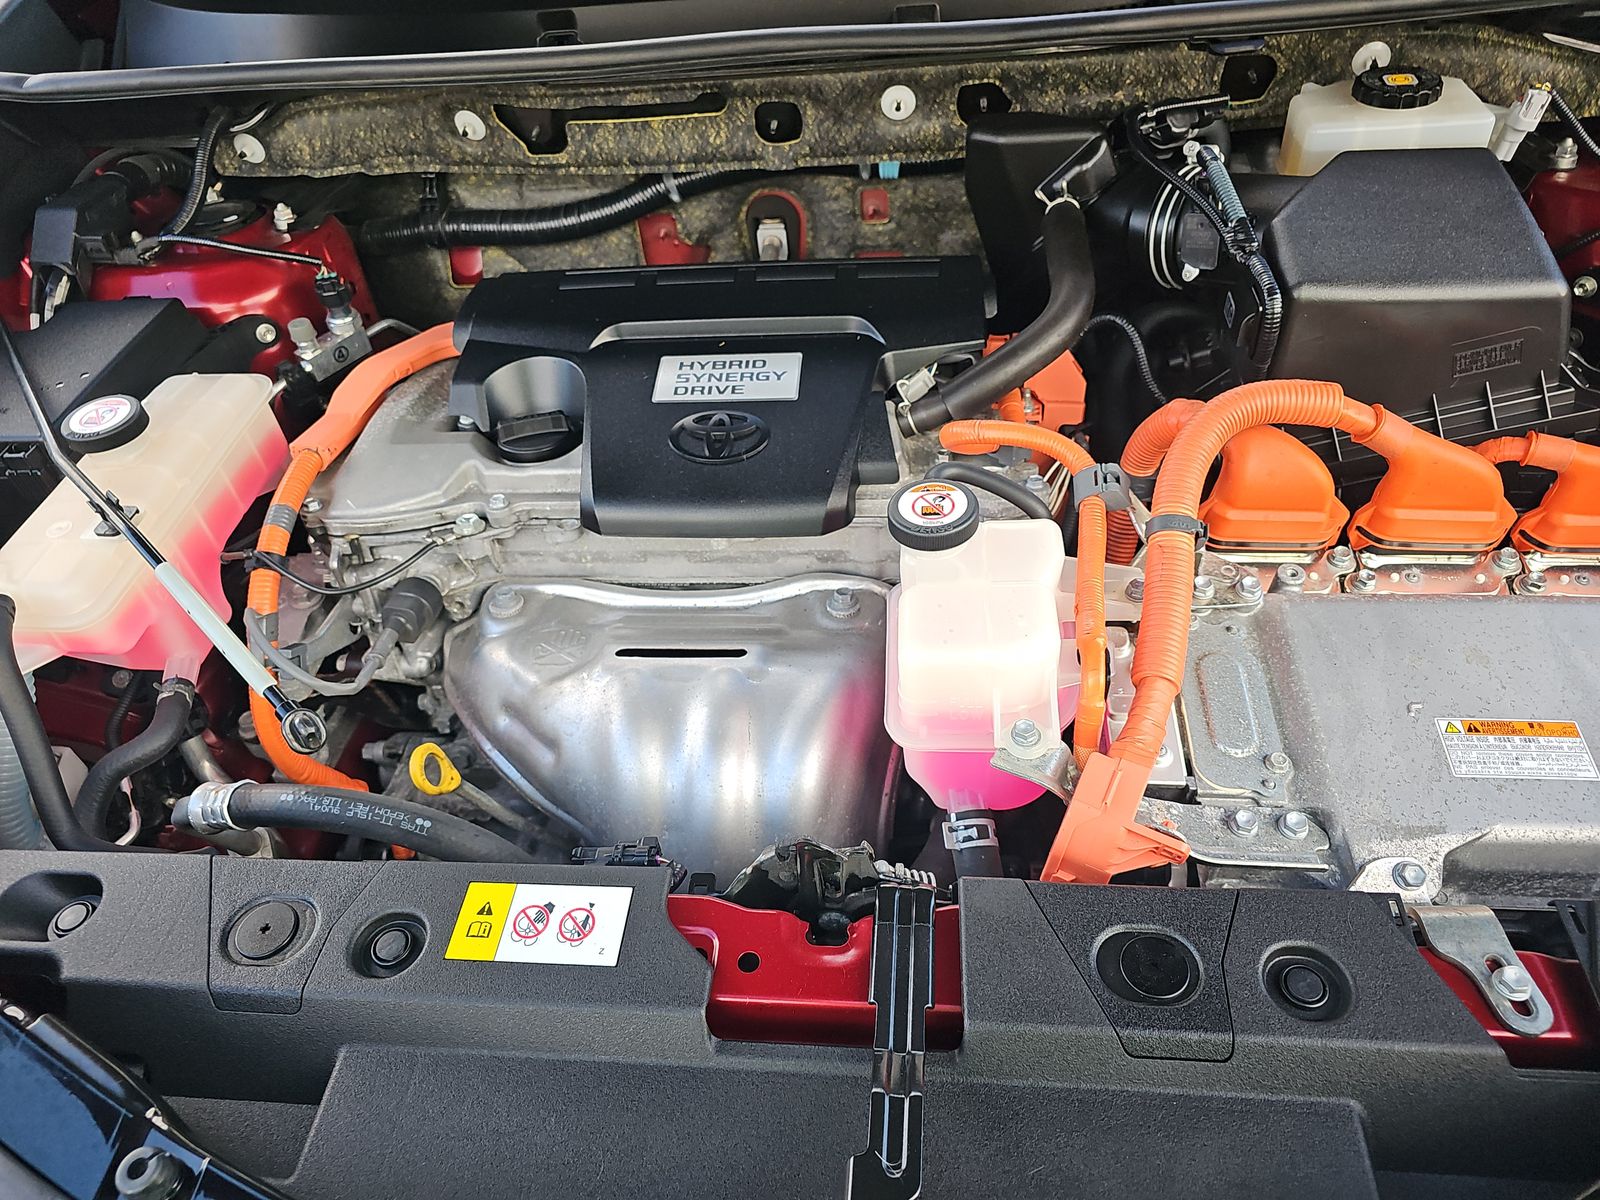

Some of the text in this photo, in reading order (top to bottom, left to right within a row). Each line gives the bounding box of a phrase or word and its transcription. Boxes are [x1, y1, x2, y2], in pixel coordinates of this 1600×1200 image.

[678, 359, 767, 371] HYBRID
[675, 371, 787, 384] SYNERGY
[673, 384, 746, 396] DRIVE
[1479, 721, 1515, 729] WARNING
[400, 820, 428, 836] TTAS
